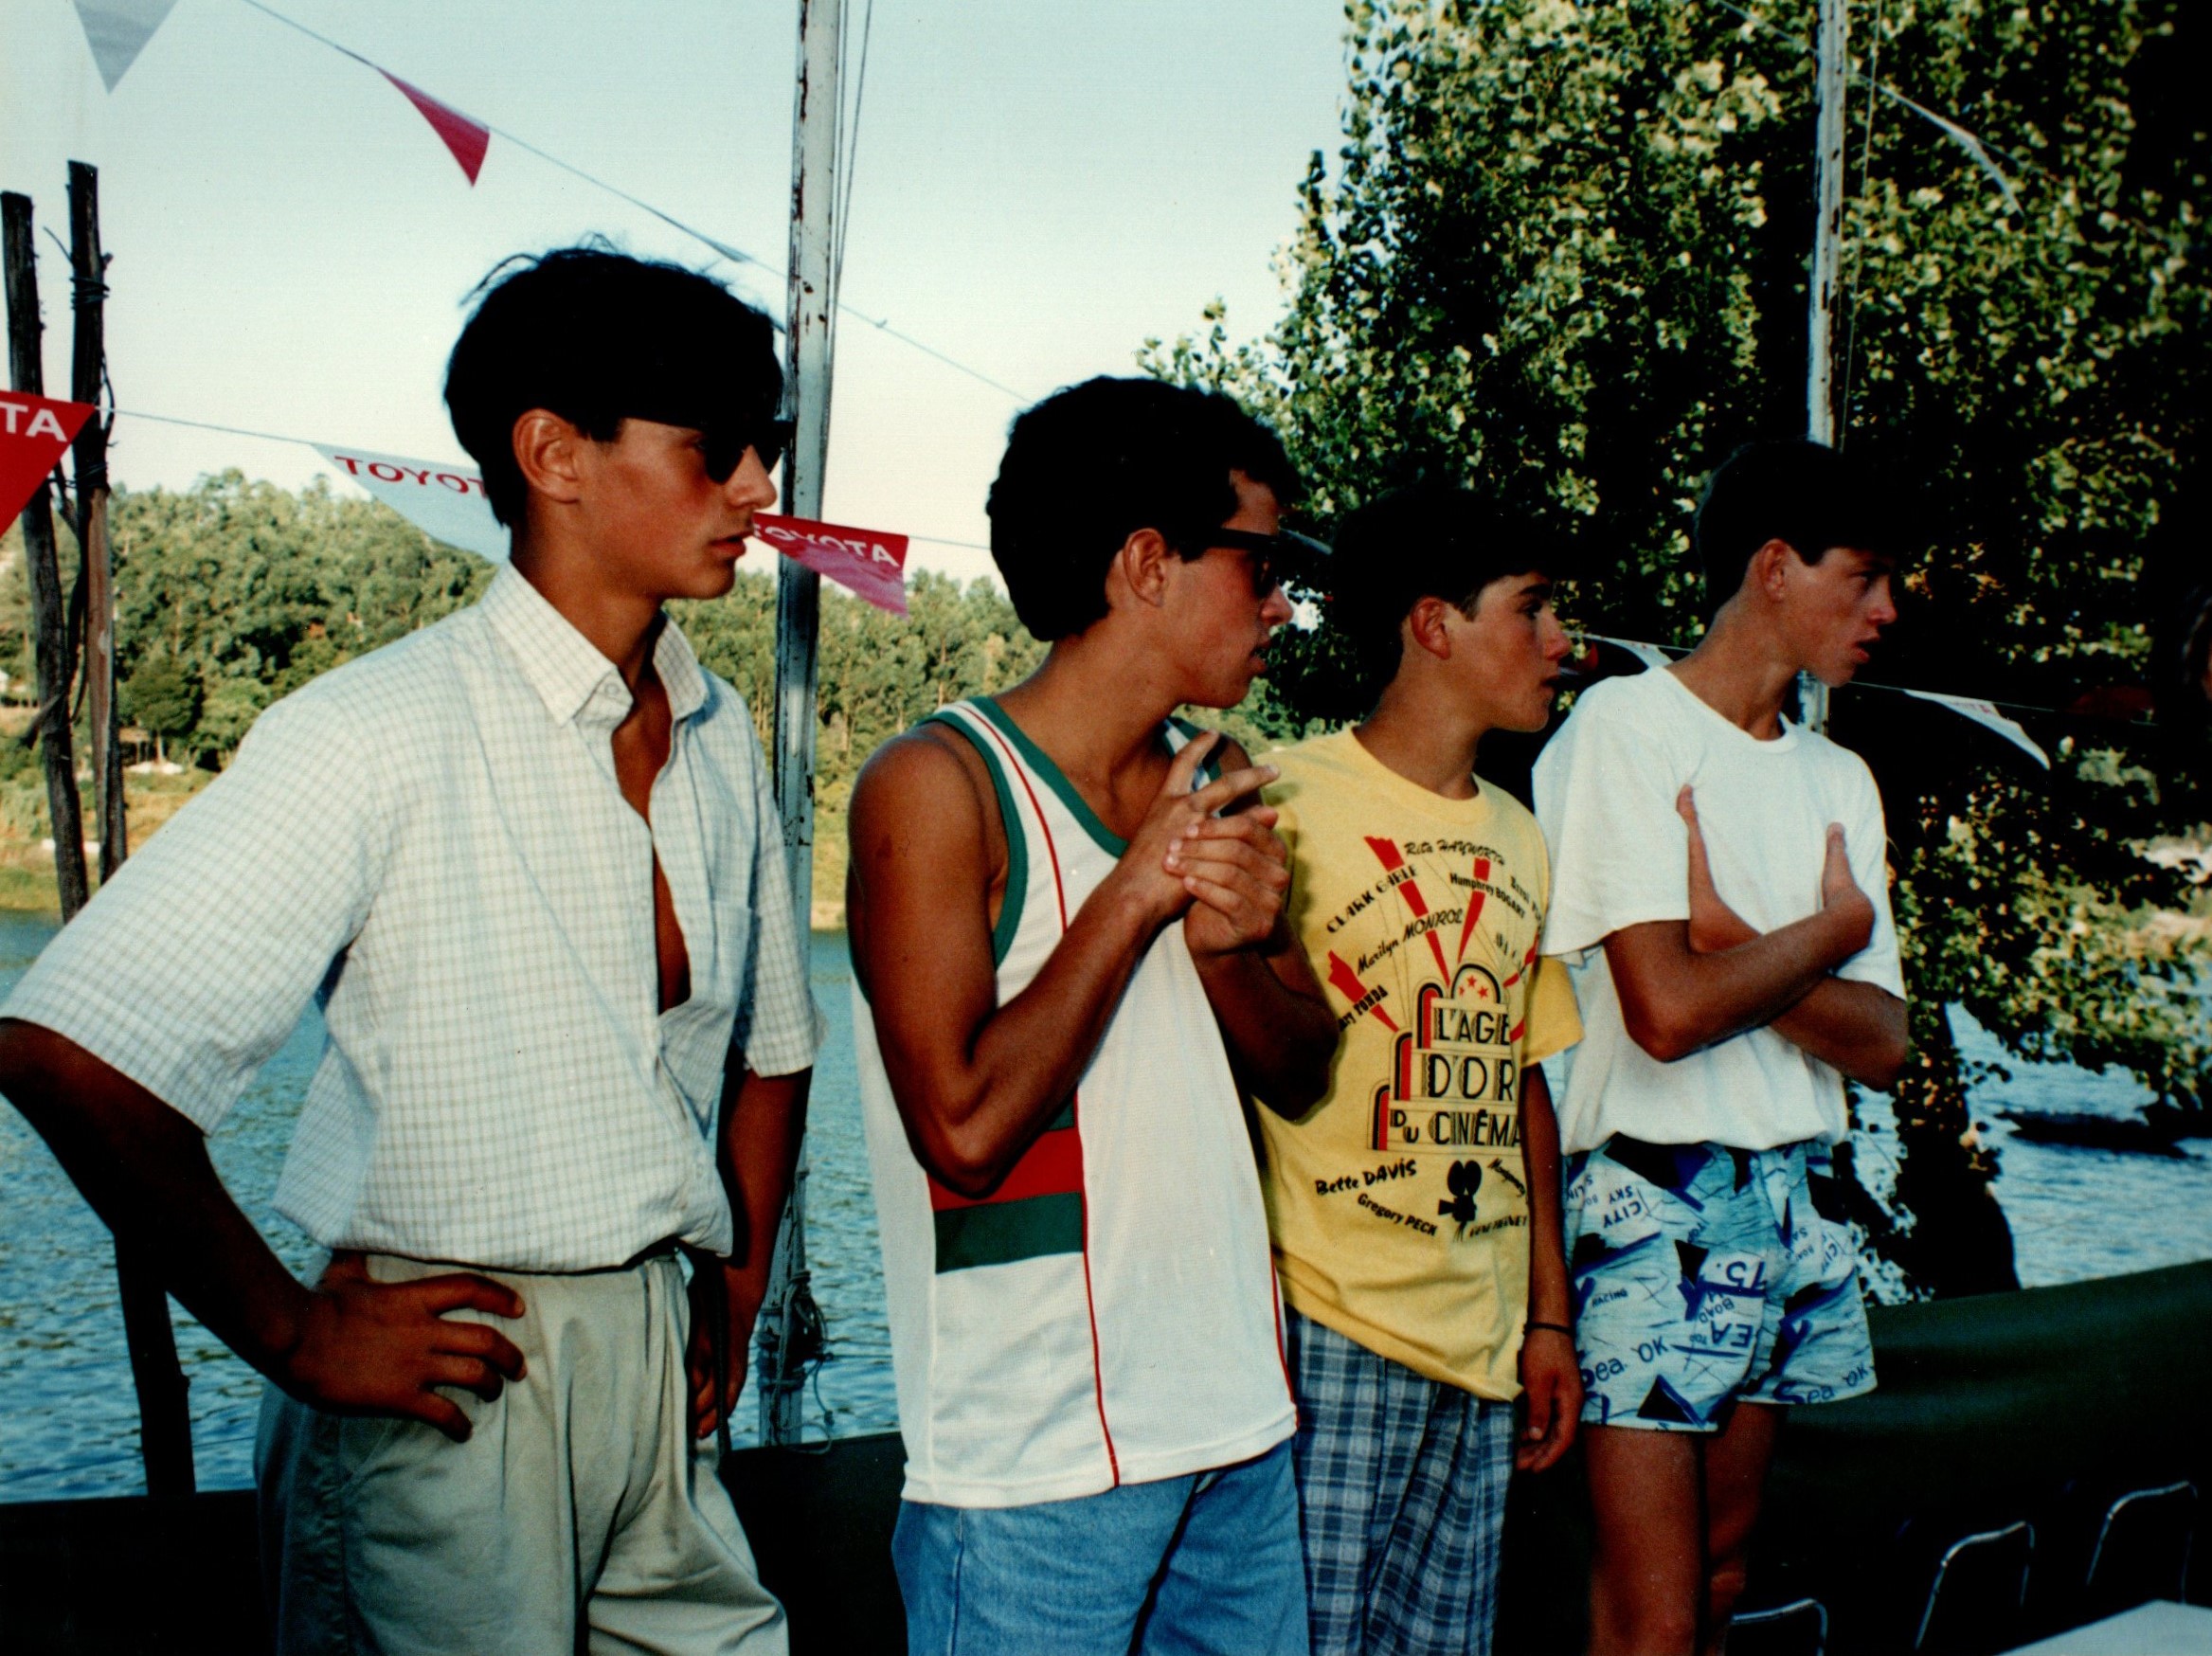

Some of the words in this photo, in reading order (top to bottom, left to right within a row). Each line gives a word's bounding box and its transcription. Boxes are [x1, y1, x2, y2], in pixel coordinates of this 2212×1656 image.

[1404, 841, 1434, 856] Rita
[1326, 890, 1376, 933] CLARK
[1449, 872, 1495, 896] Humphrey
[1495, 886, 1526, 920] BOGART
[1357, 939, 1400, 977] Marilyn
[1421, 1053, 1515, 1102] D'OR
[1314, 1176, 1360, 1196] Bette
[1609, 1184, 1634, 1205] SKY
[1358, 1193, 1404, 1225] Gregory
[1405, 1214, 1438, 1236] PECK
[1603, 1199, 1642, 1229] CITY
